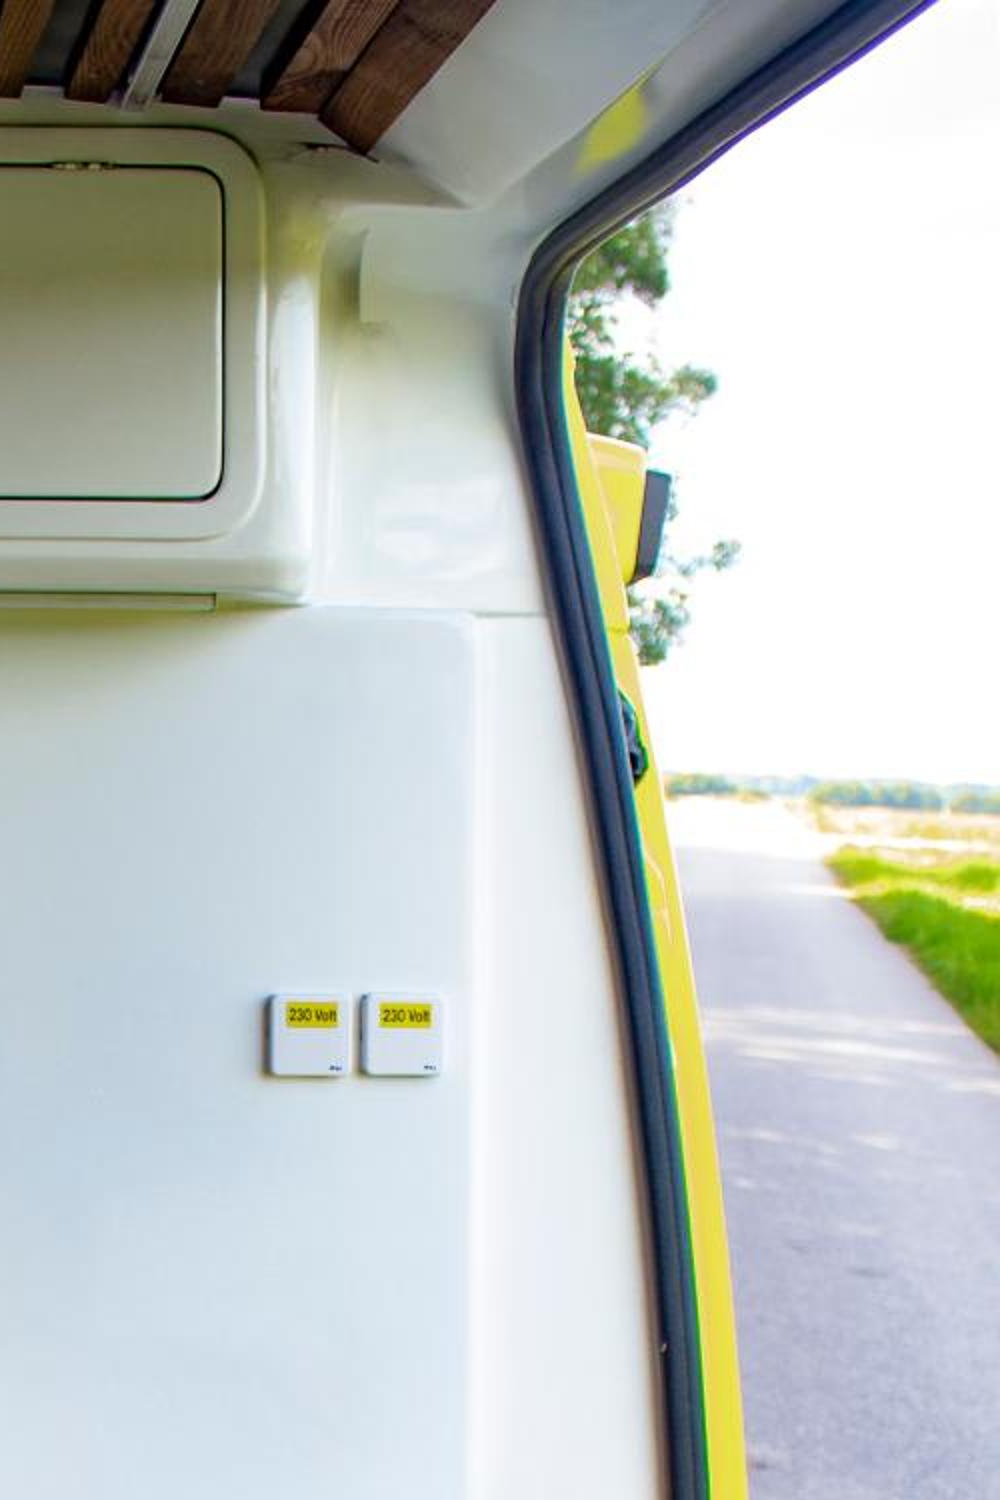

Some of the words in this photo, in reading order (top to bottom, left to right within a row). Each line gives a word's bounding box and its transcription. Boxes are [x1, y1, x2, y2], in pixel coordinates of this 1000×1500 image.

[289, 1008, 312, 1021] 230
[316, 1008, 338, 1022] Volt
[383, 1009, 406, 1022] 230
[409, 1009, 431, 1023] Volt
